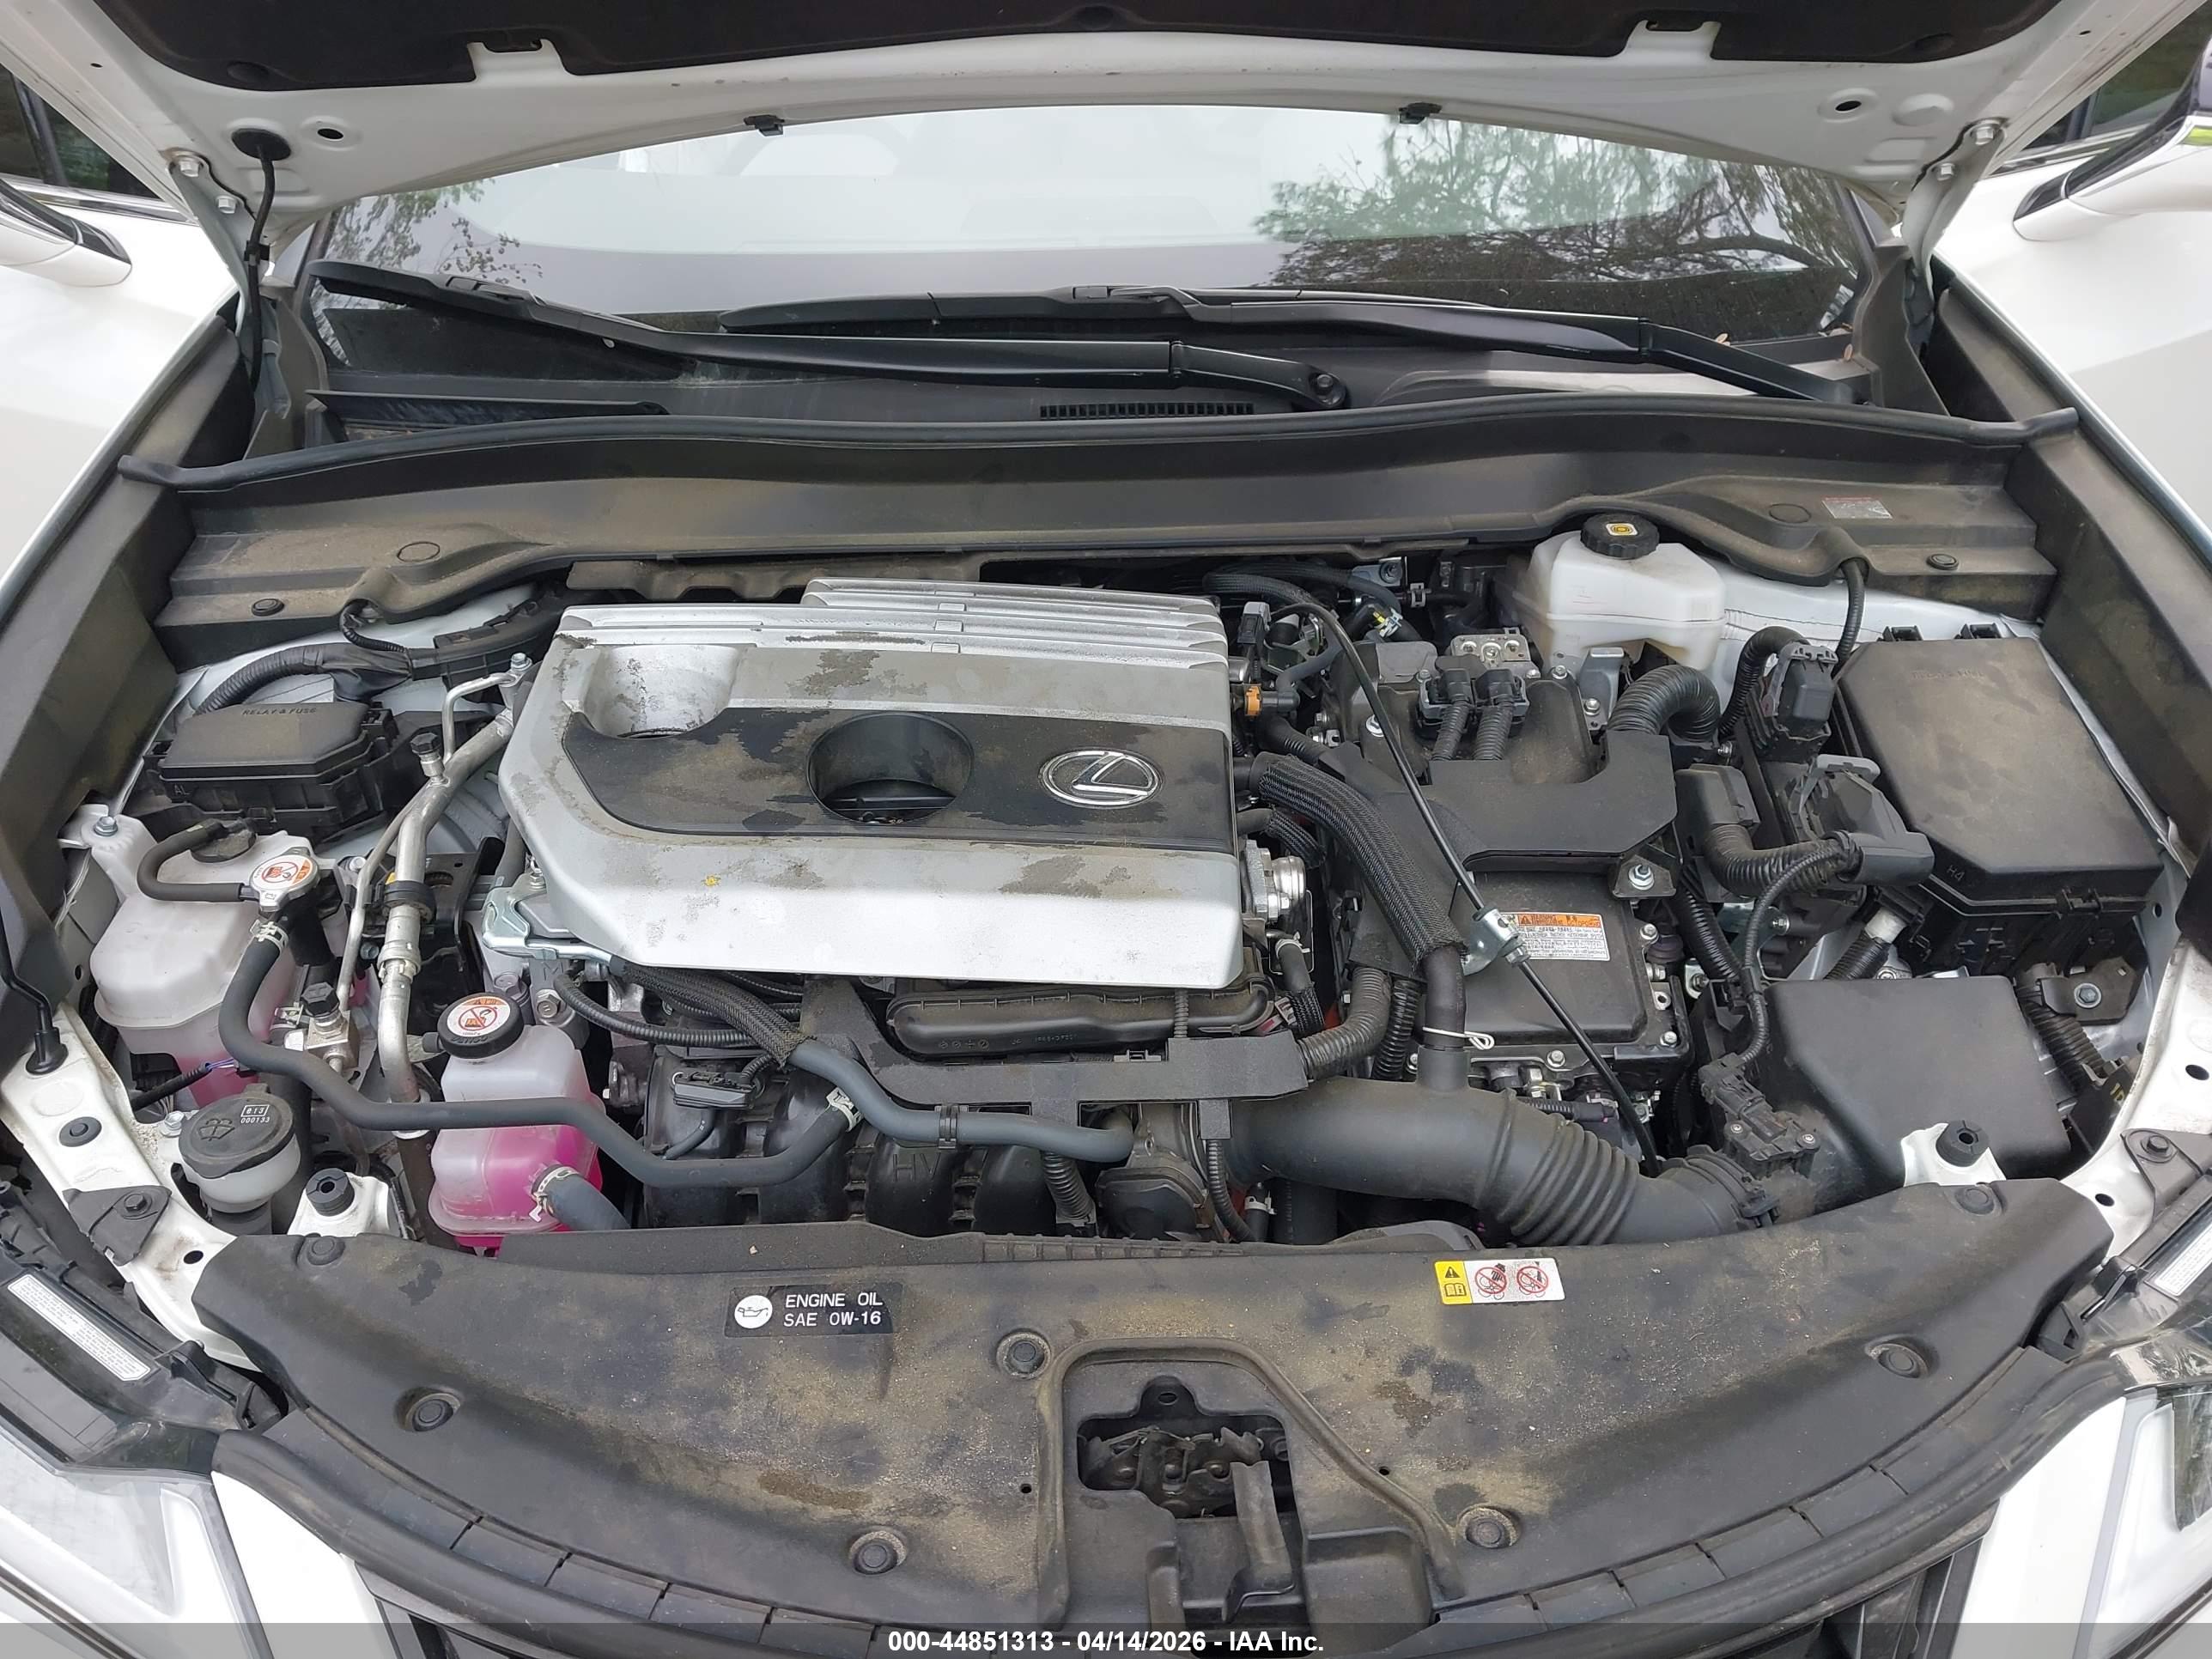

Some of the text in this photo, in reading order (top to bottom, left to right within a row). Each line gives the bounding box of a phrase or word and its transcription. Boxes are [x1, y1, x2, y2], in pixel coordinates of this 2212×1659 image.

[785, 1292, 884, 1309] ENGINE OIL
[783, 1310, 882, 1328] SAE 0W-16
